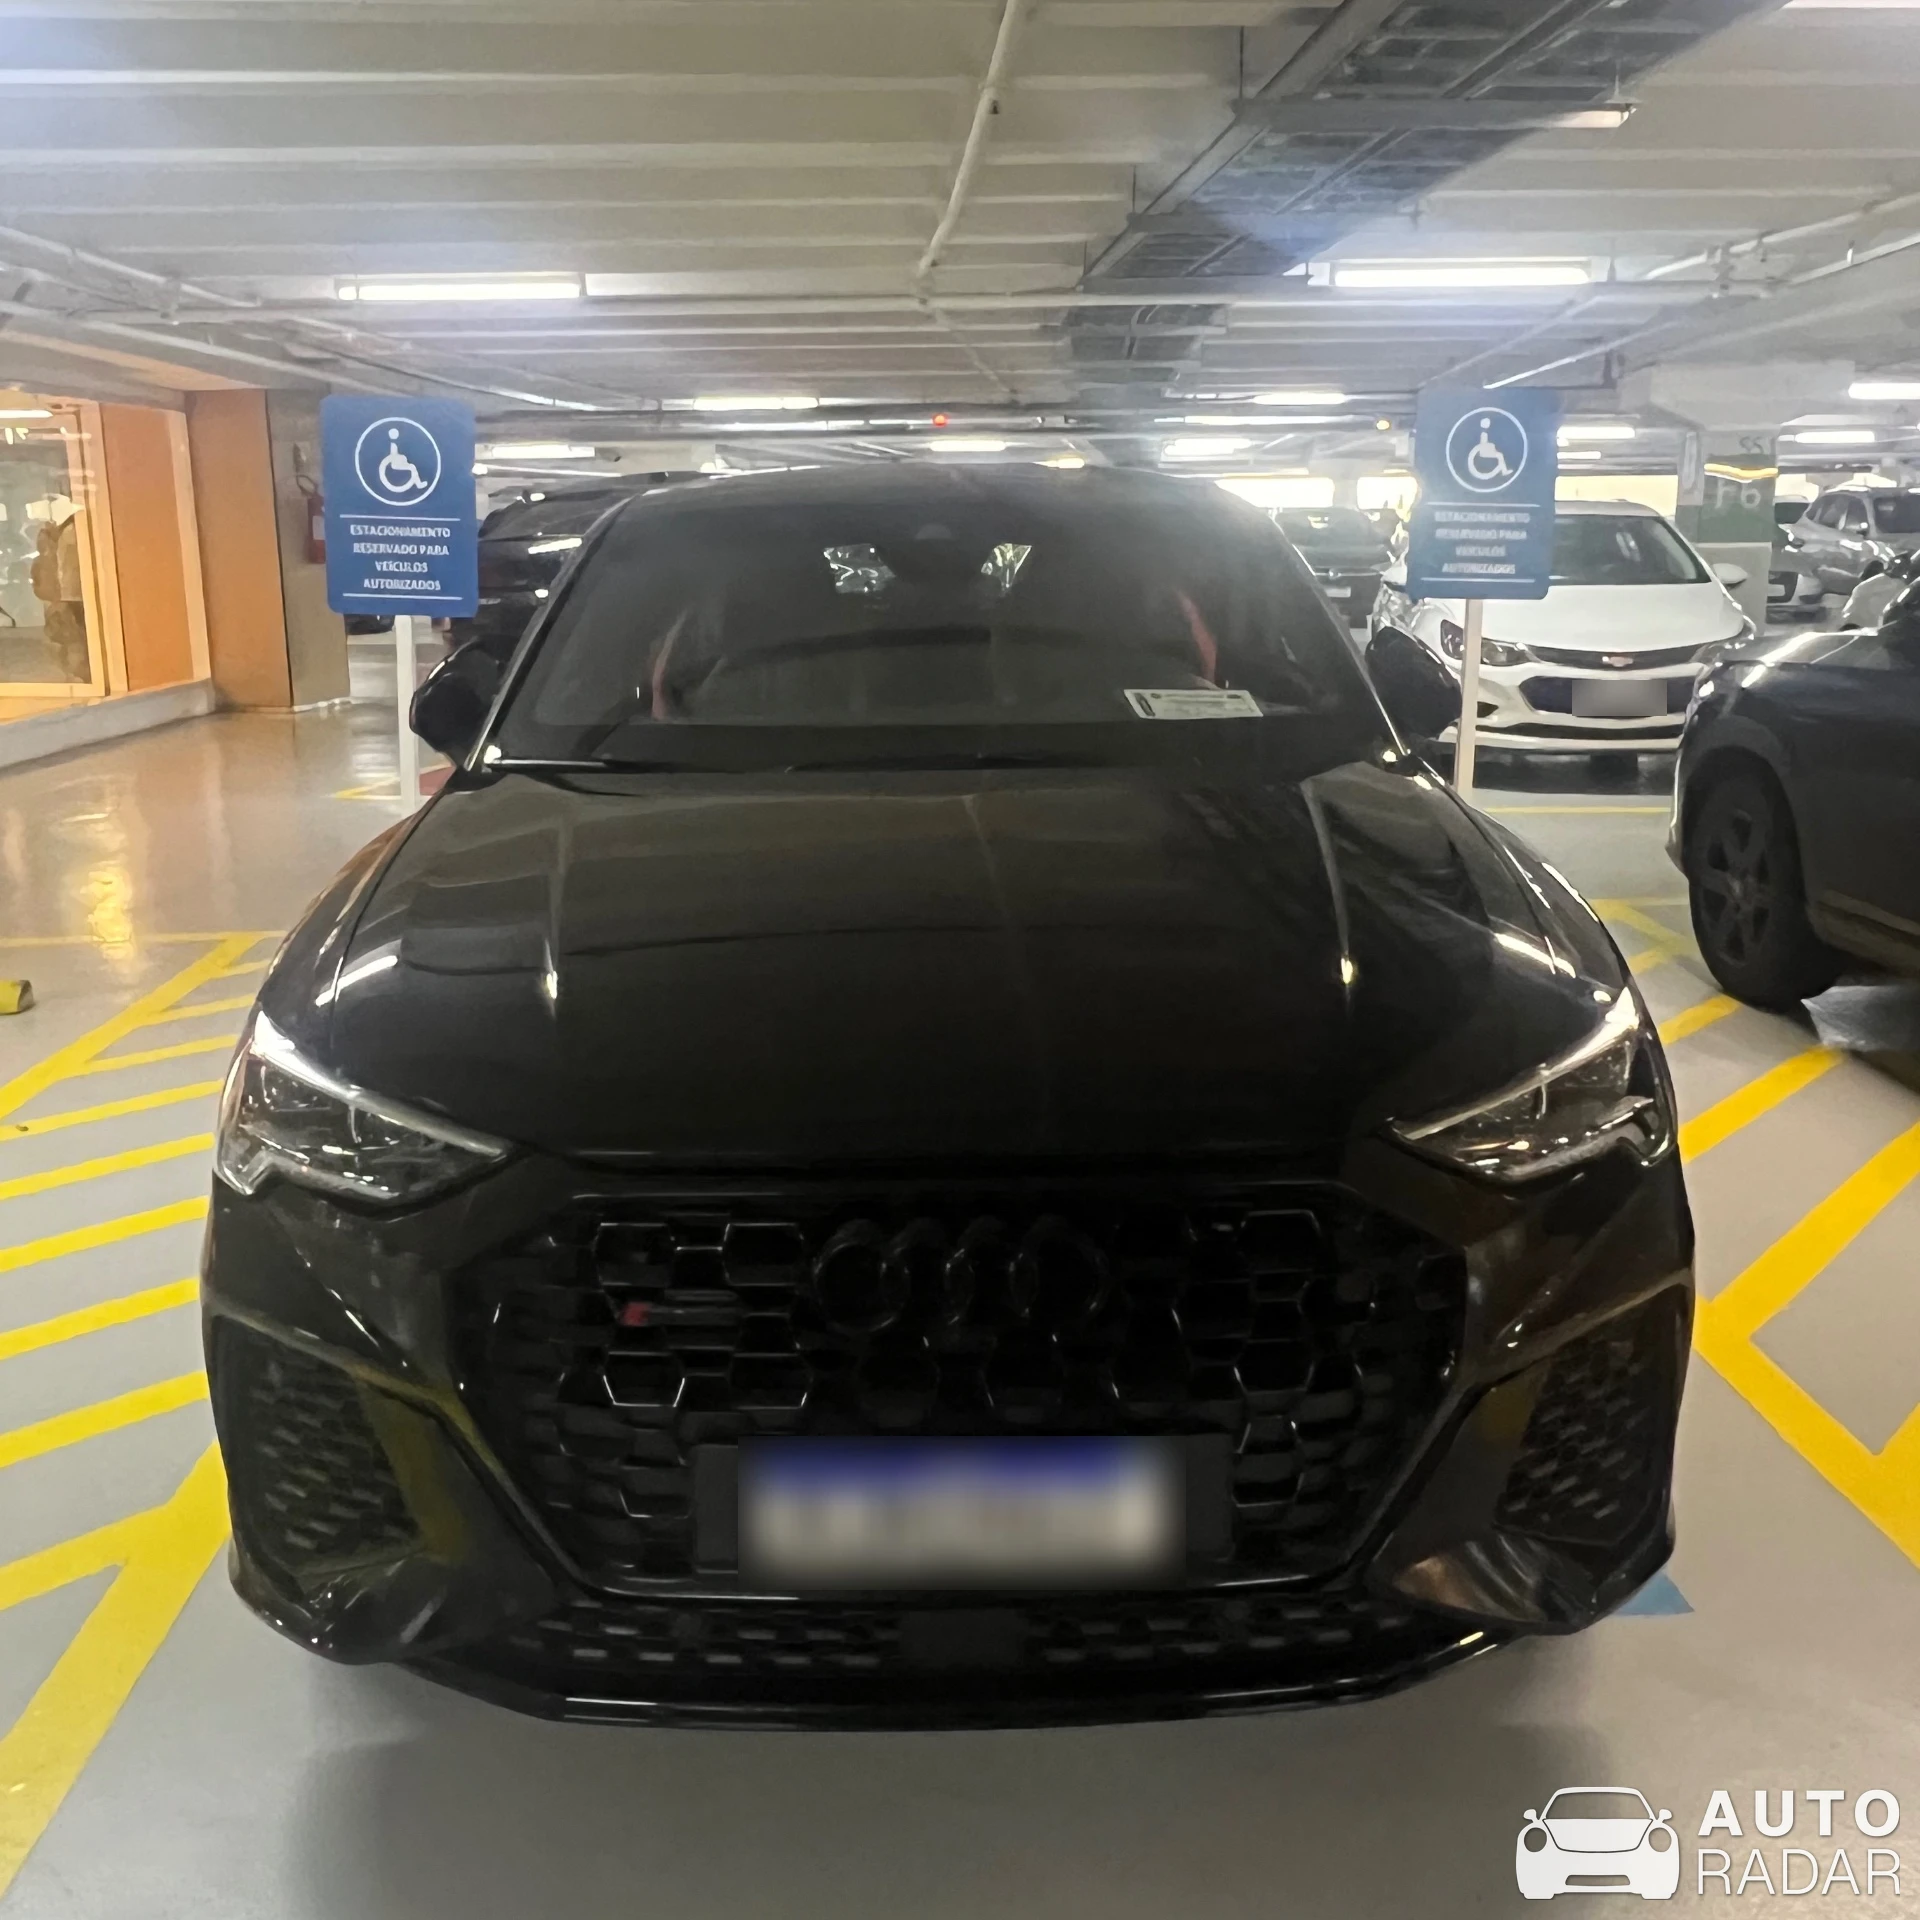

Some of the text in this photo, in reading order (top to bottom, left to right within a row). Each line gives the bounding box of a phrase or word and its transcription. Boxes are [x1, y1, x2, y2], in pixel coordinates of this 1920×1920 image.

[349, 524, 451, 538] ESTACIONAMENTO
[353, 542, 450, 556] RESERVADO PARA
[363, 578, 442, 591] AUTORIZADOS
